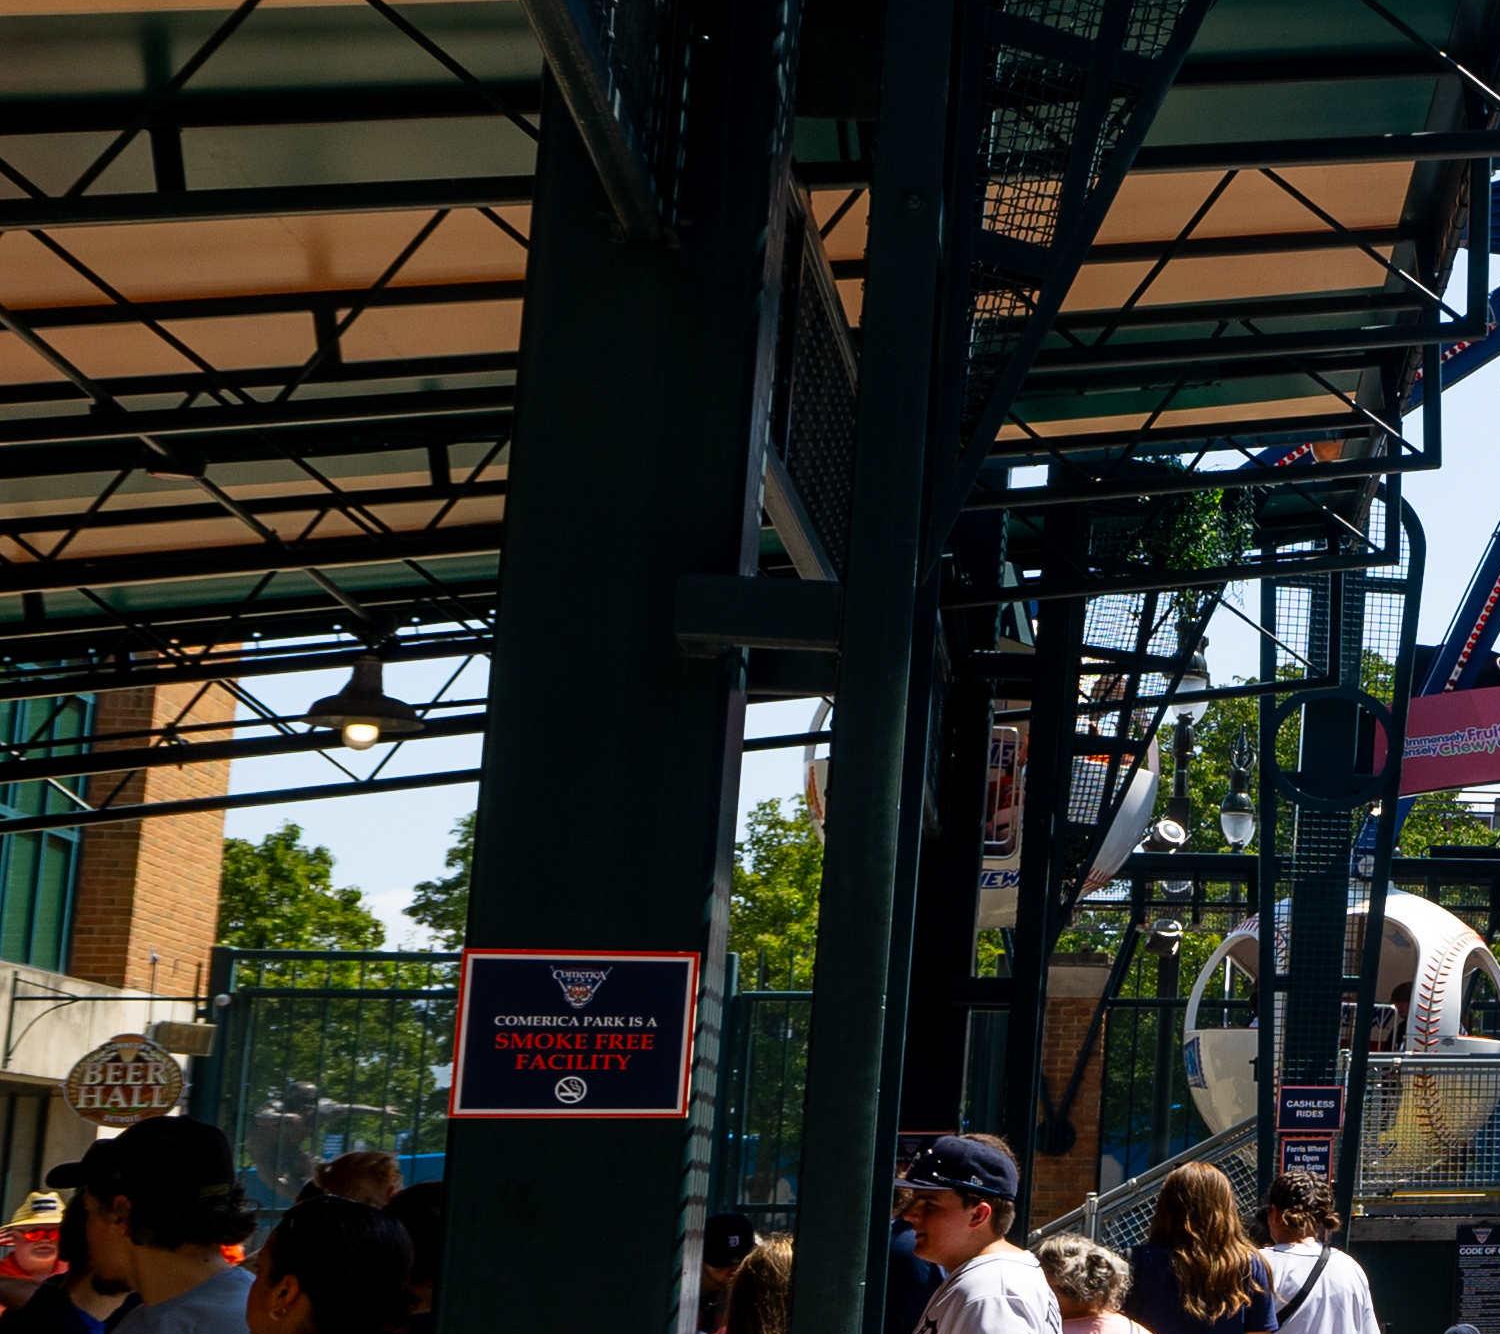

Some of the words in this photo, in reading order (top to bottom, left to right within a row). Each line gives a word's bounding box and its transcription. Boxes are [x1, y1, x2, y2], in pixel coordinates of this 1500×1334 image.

[1404, 731, 1466, 748] Immensely
[1438, 738, 1497, 758] Chewy
[494, 1015, 579, 1028] COMERICA
[583, 1016, 625, 1028] PARK
[629, 1017, 643, 1028] IS
[646, 1018, 658, 1028] A
[495, 1032, 588, 1050] SMOKE
[595, 1033, 655, 1050] FREE
[515, 1053, 632, 1071] FACILITY
[82, 1062, 168, 1085] BEER
[75, 1085, 169, 1108] HALL
[1286, 1099, 1336, 1109] CASHLESS
[1296, 1110, 1325, 1119] RIDES
[1459, 1247, 1484, 1256] CODE
[1485, 1247, 1497, 1256] OF
